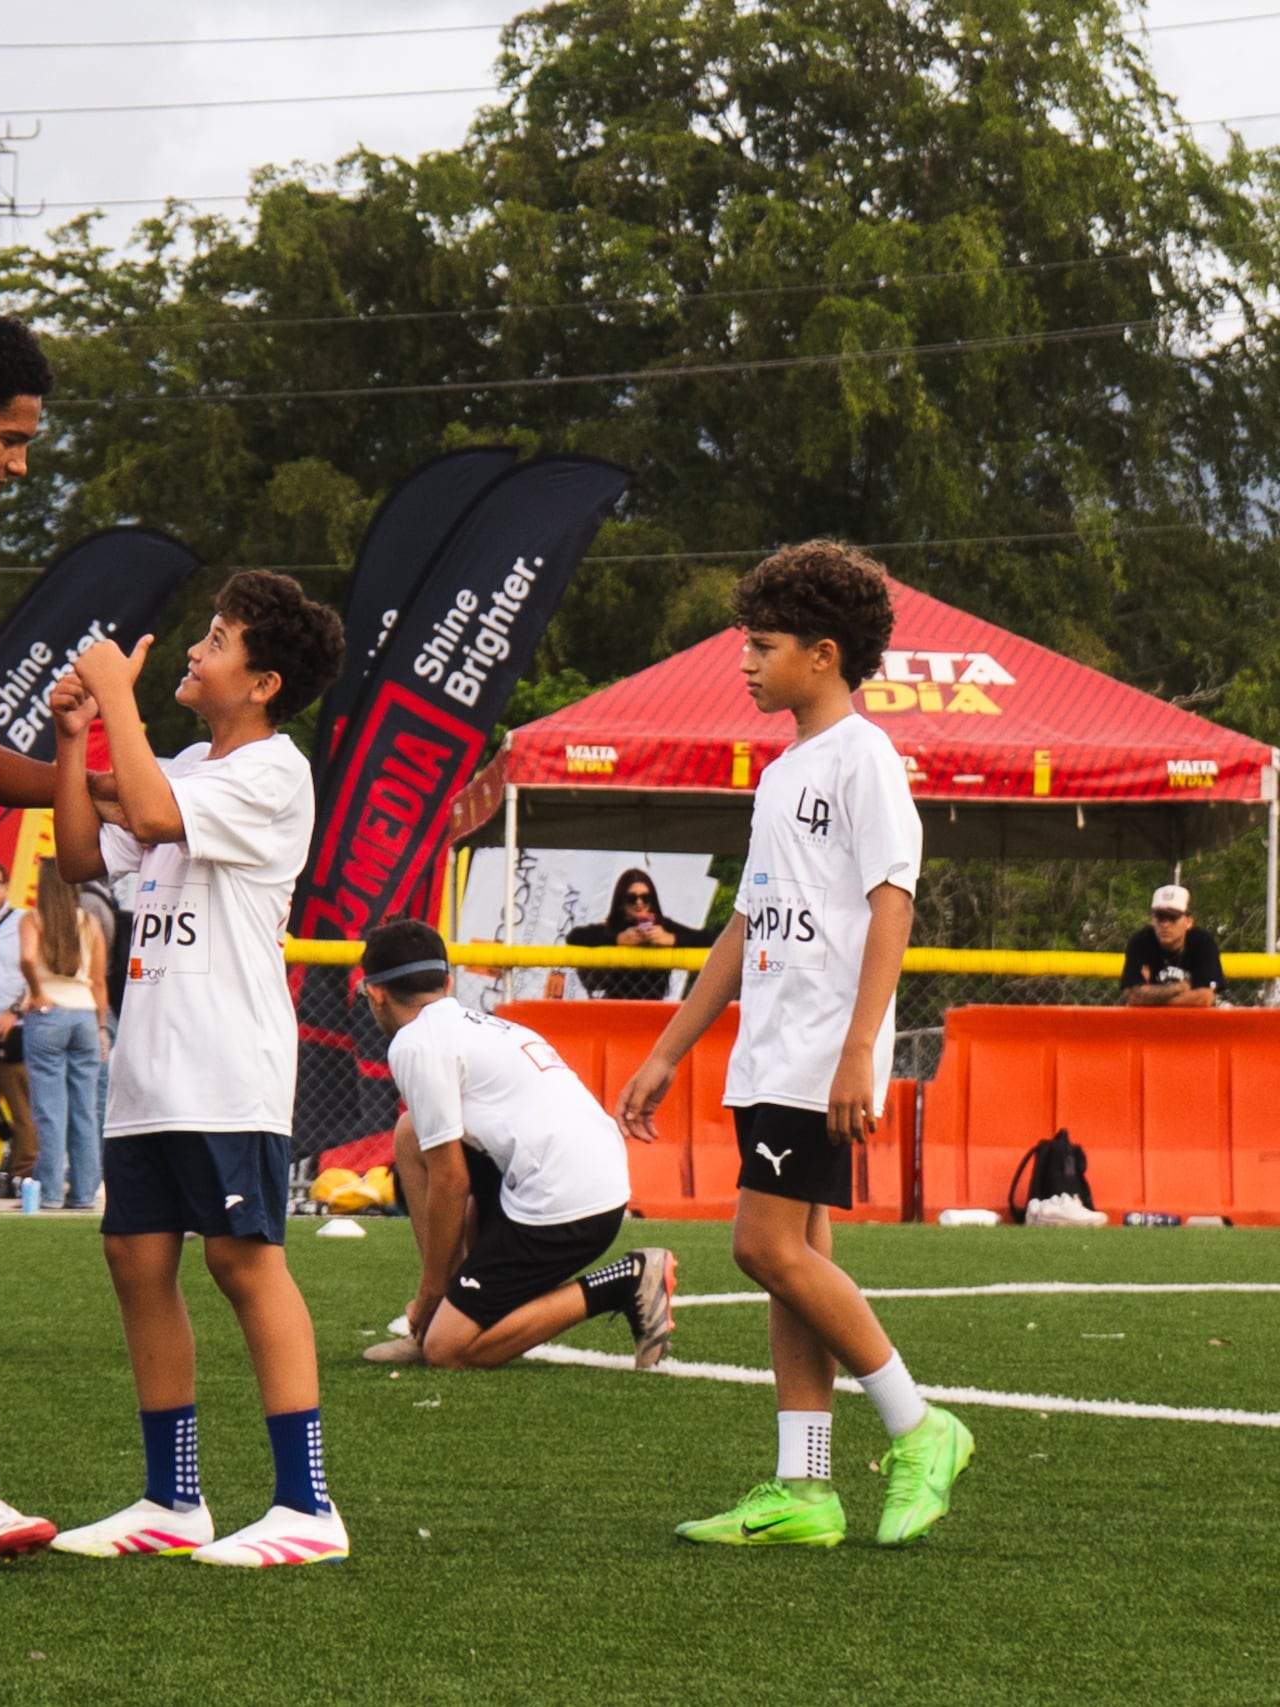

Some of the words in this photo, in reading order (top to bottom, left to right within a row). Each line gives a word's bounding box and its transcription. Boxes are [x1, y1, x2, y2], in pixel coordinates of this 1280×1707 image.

[413, 588, 479, 685] Shine
[443, 556, 545, 708] Brighter.
[566, 744, 619, 762] MALTA
[1166, 760, 1219, 775] MALTA
